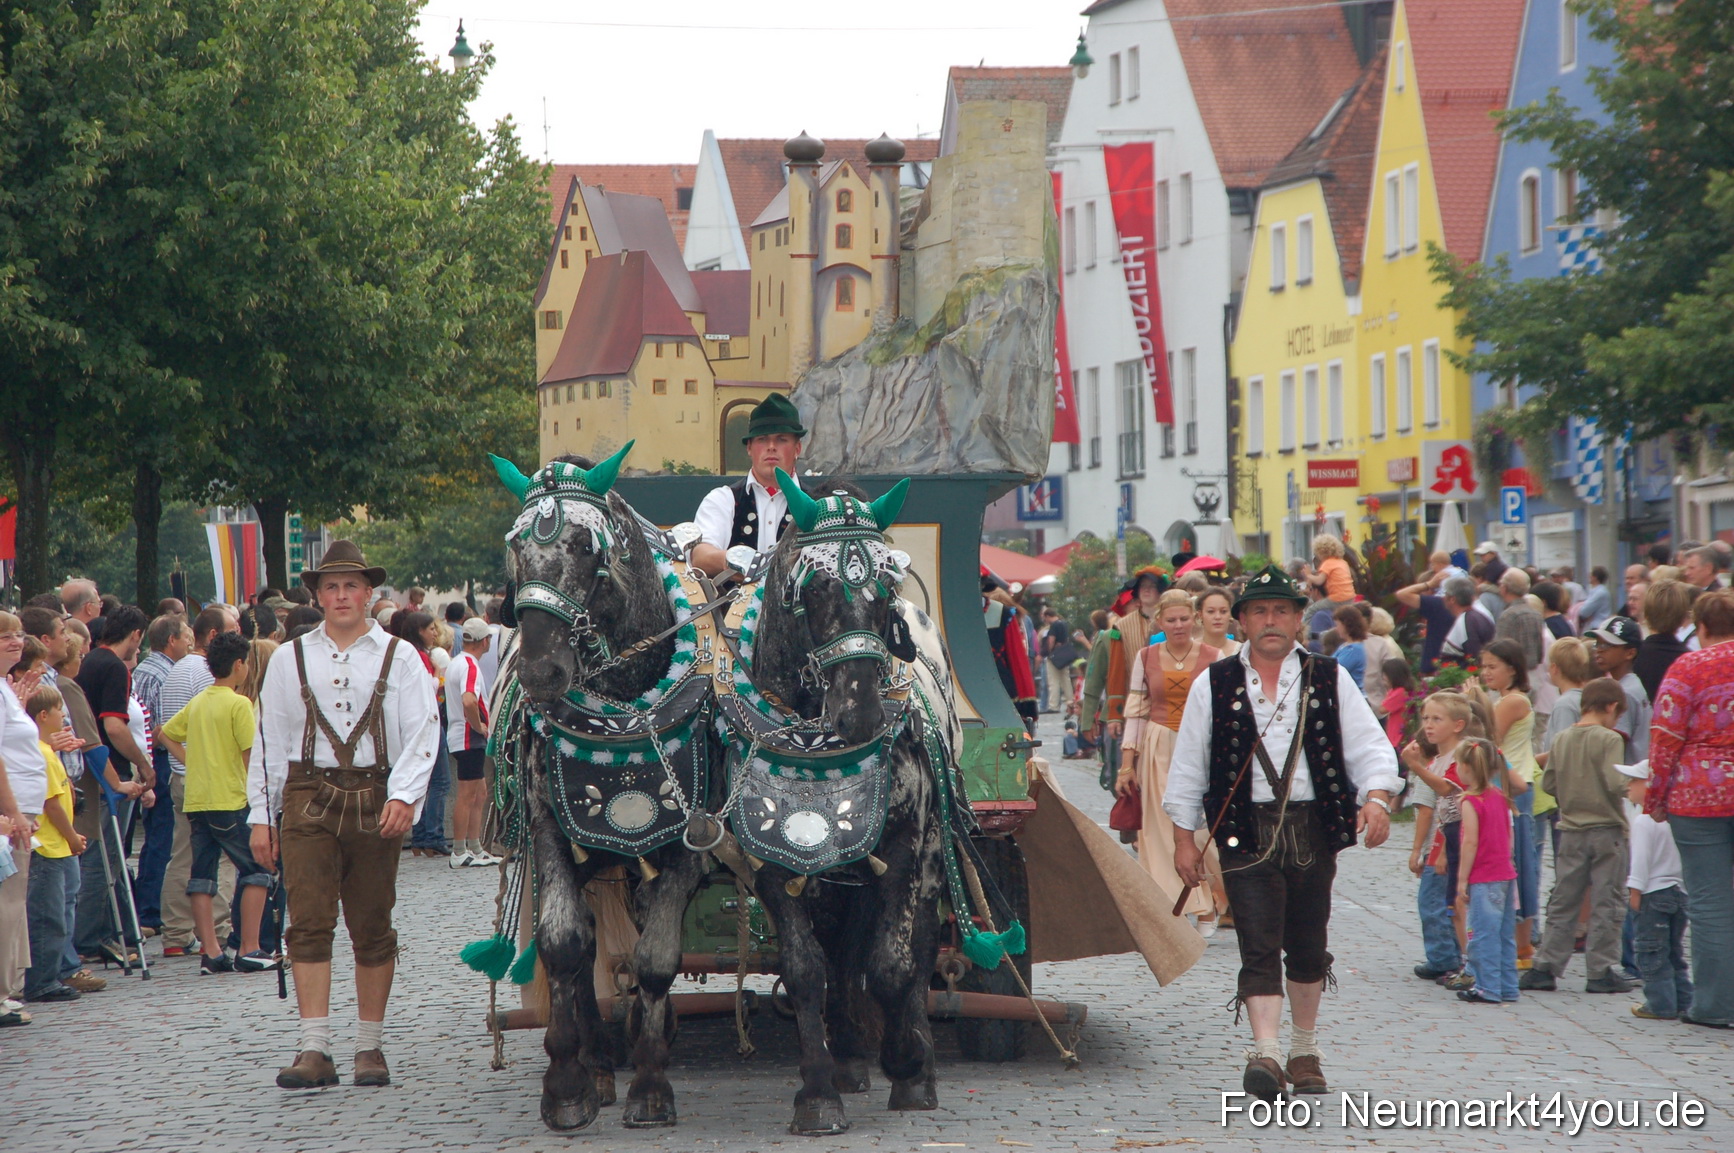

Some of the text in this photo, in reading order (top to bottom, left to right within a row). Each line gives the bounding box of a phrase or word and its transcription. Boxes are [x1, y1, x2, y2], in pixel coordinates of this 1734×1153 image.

[1119, 231, 1159, 395] EDUZIERT
[1286, 324, 1316, 358] HOTEL
[1309, 467, 1358, 480] WISSMACH
[1505, 490, 1521, 522] P
